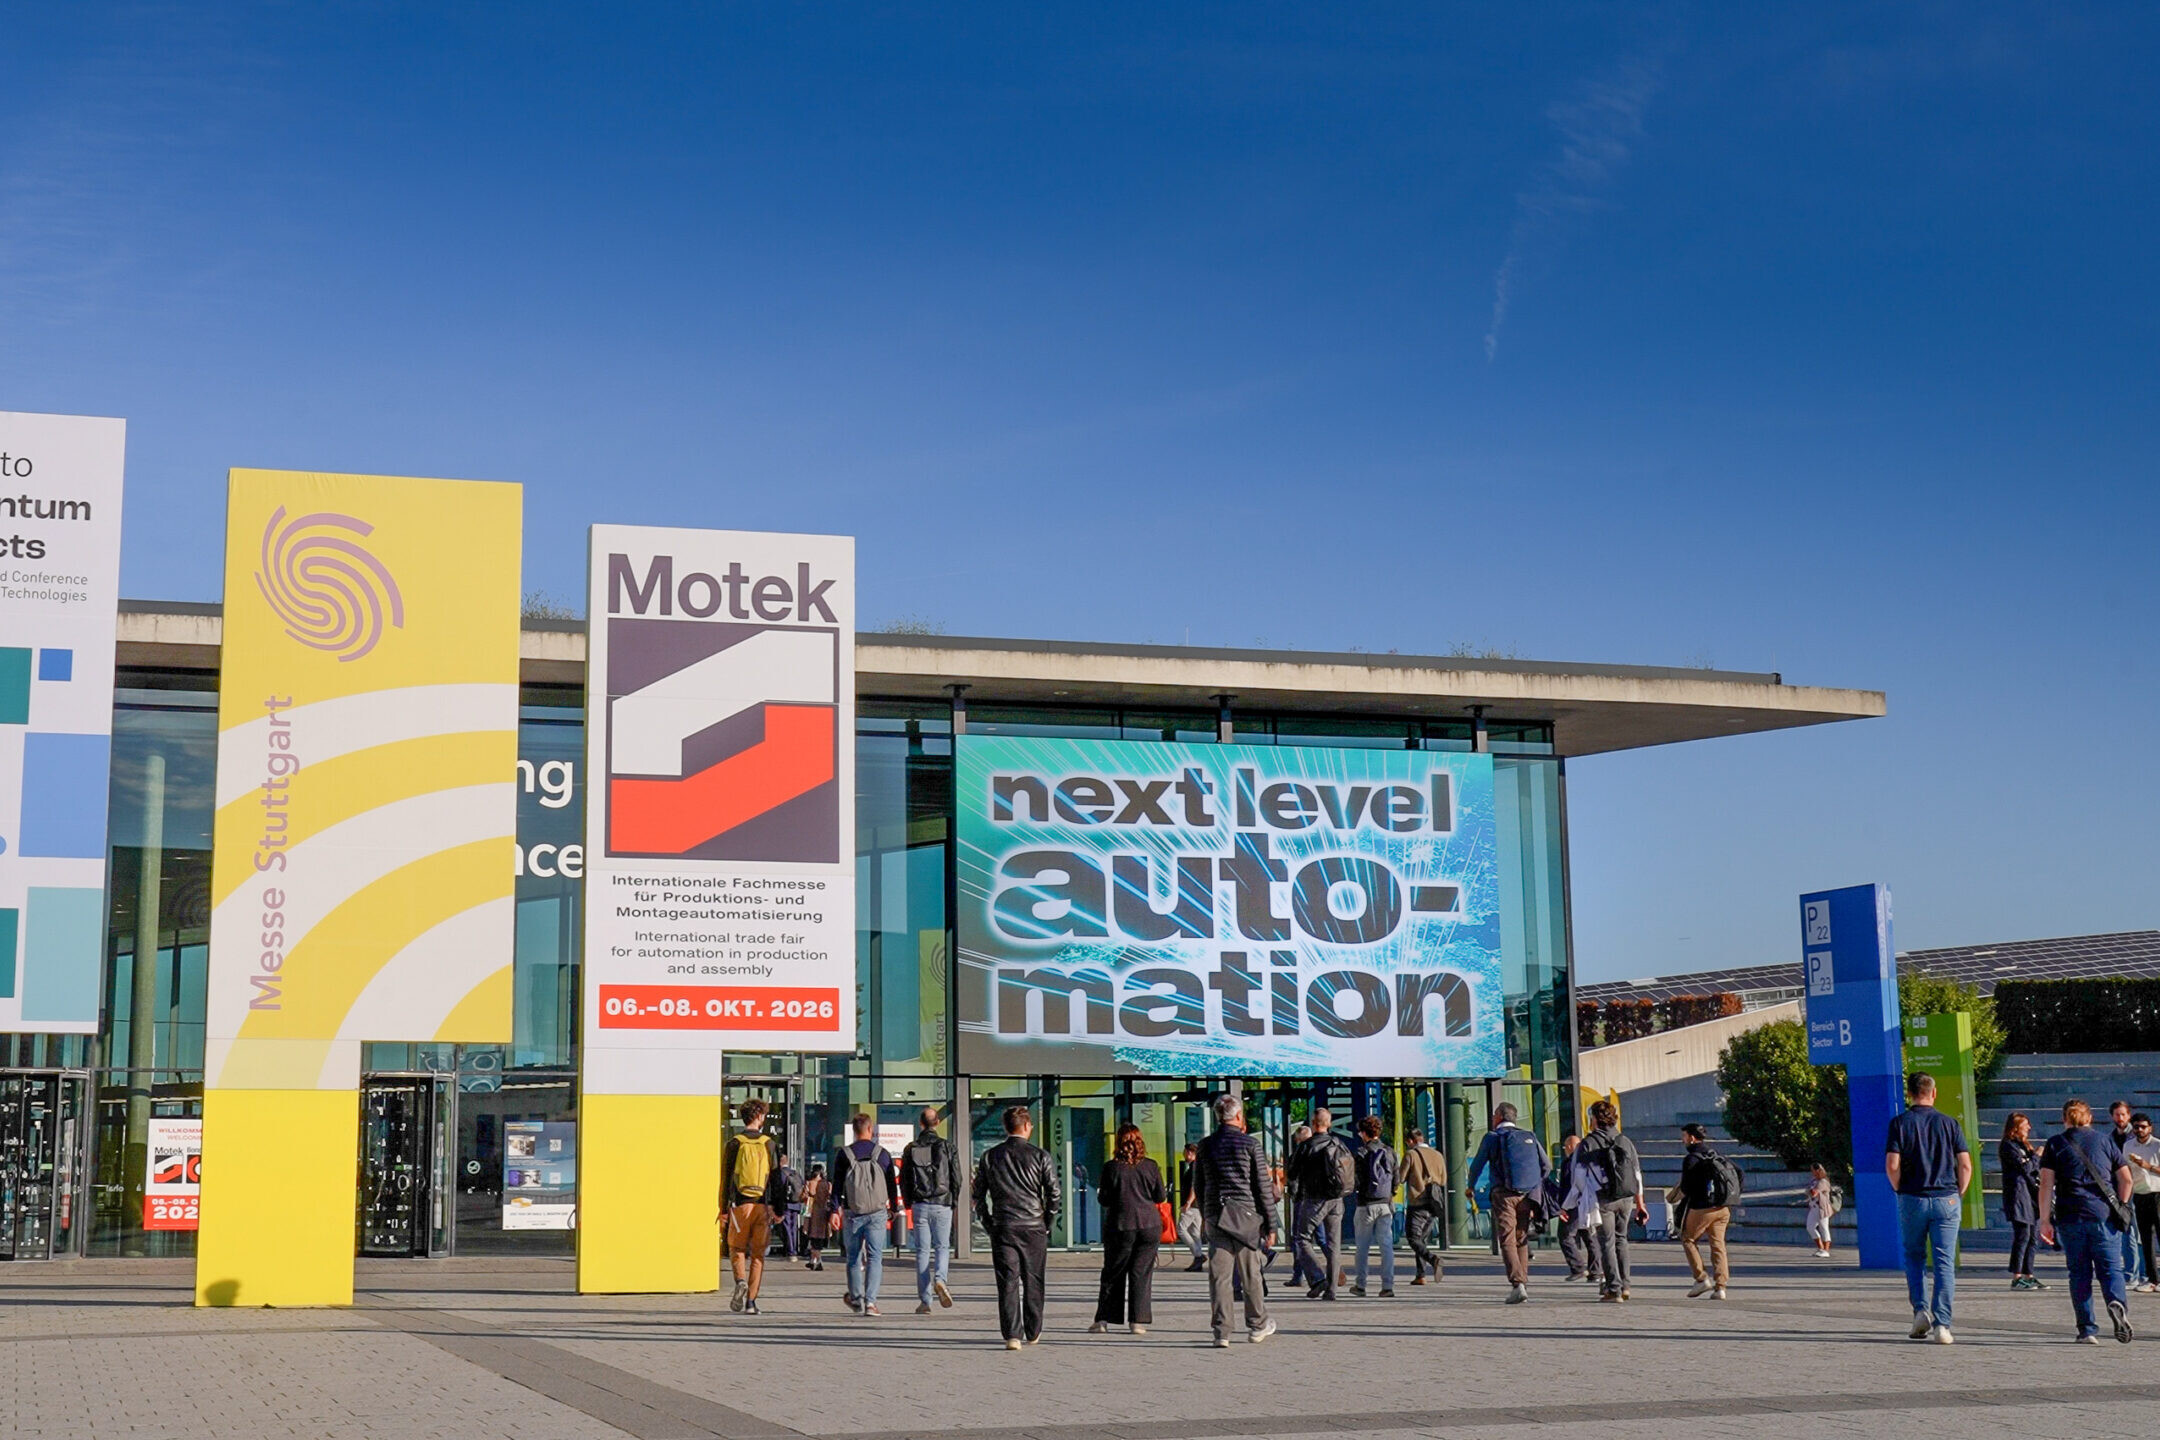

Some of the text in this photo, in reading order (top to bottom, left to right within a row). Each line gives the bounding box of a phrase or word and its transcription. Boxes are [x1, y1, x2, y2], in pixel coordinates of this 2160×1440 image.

[0, 452, 33, 478] to
[12, 571, 88, 585] Conference
[1, 586, 87, 603] Technologies
[607, 553, 838, 623] Motek
[992, 767, 1452, 832] next level
[249, 695, 300, 1010] Messe Stuttgart
[612, 875, 826, 890] Internationale Fachmesse
[992, 832, 1460, 944] auto-
[634, 891, 804, 905] für Produktions- und
[616, 907, 823, 923] Montageautomatisierung
[1807, 906, 1828, 940] P 22
[635, 931, 805, 944] International trade fair
[611, 946, 828, 960] for automation in production
[667, 964, 773, 977] and assembly
[1810, 957, 1832, 991] P 23
[997, 950, 1474, 1038] mation
[705, 999, 763, 1017] OKT.
[770, 1000, 834, 1018] 2026
[1839, 1019, 1852, 1046] B
[1812, 1037, 1833, 1048] Sector
[155, 1147, 183, 1155] Motek
[153, 1206, 198, 1219] 202
